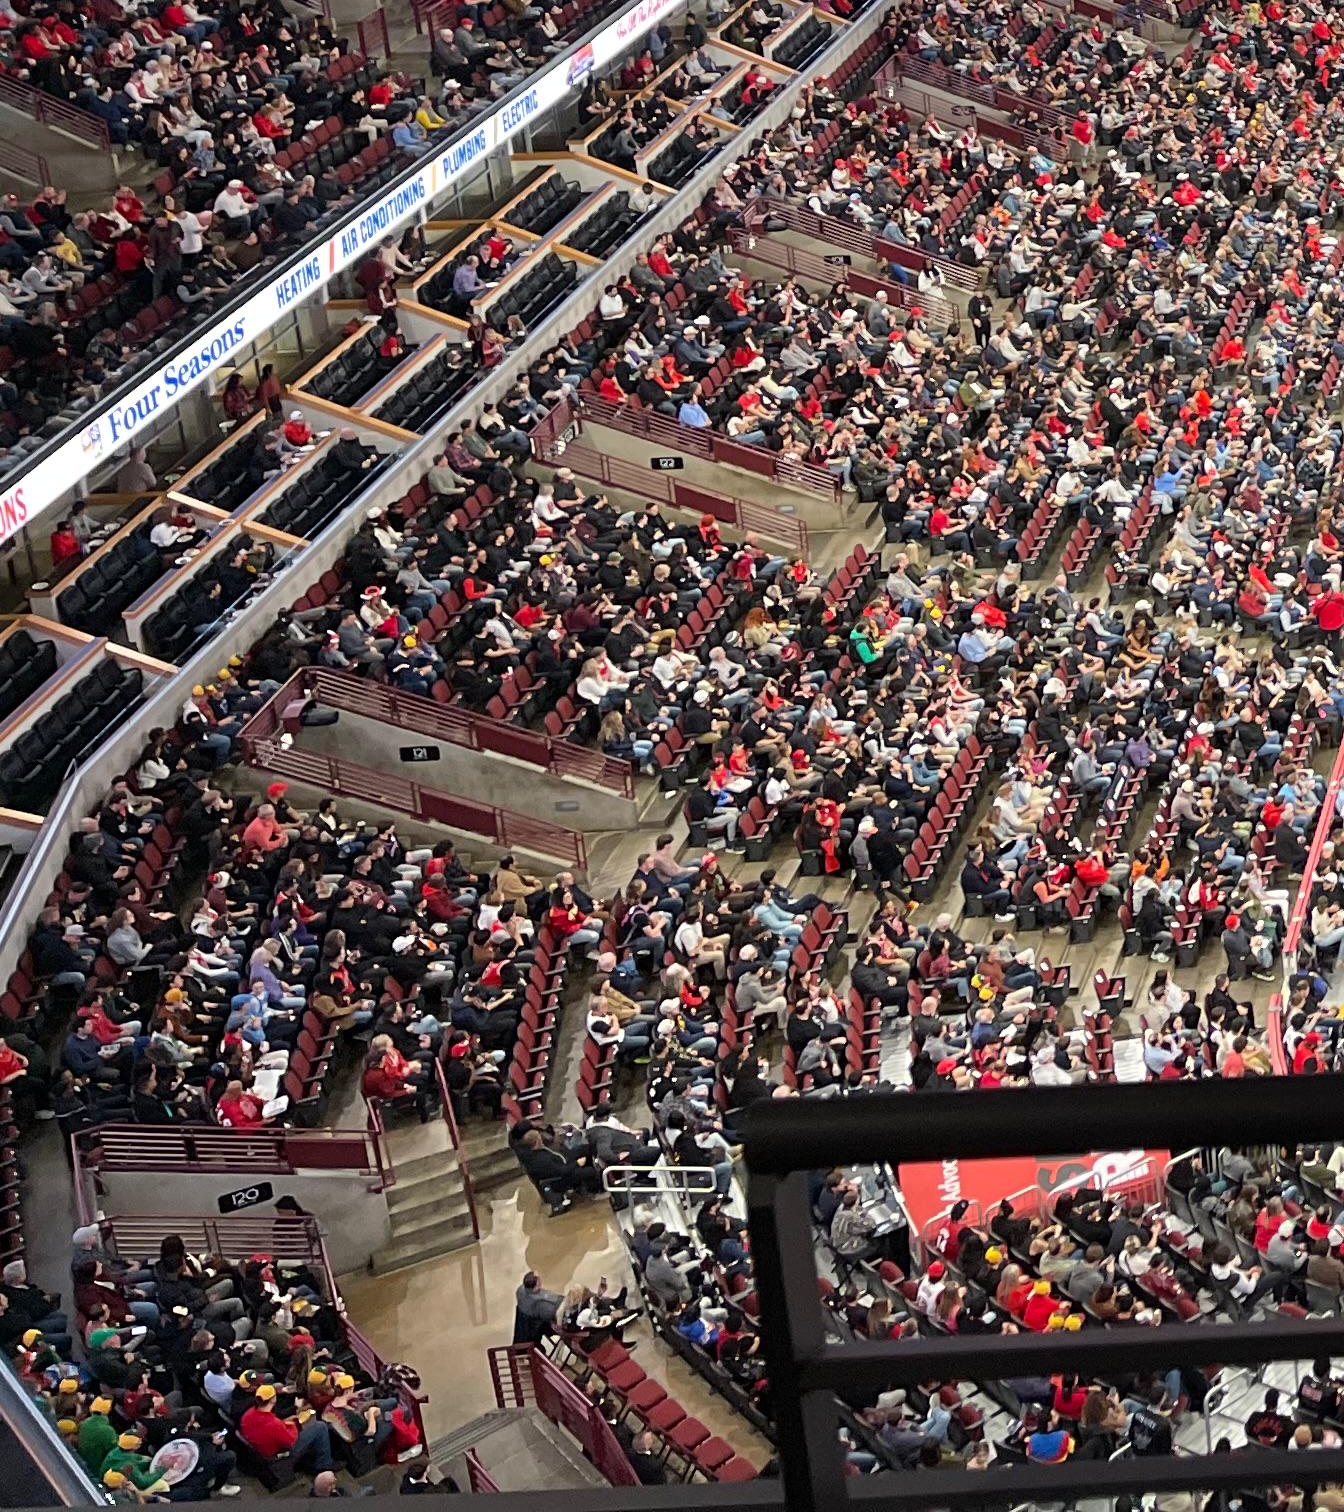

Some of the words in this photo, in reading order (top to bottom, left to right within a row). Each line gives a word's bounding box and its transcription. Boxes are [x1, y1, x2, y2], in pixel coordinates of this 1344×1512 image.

[107, 388, 160, 442] Four
[163, 317, 247, 395] Seasons
[275, 256, 321, 308] HEATING
[341, 233, 358, 257] AIR
[359, 177, 425, 242] CONDITIONING
[442, 129, 486, 179] PLUMBING
[502, 90, 539, 132] ELECTRIC
[232, 1188, 259, 1205] 120
